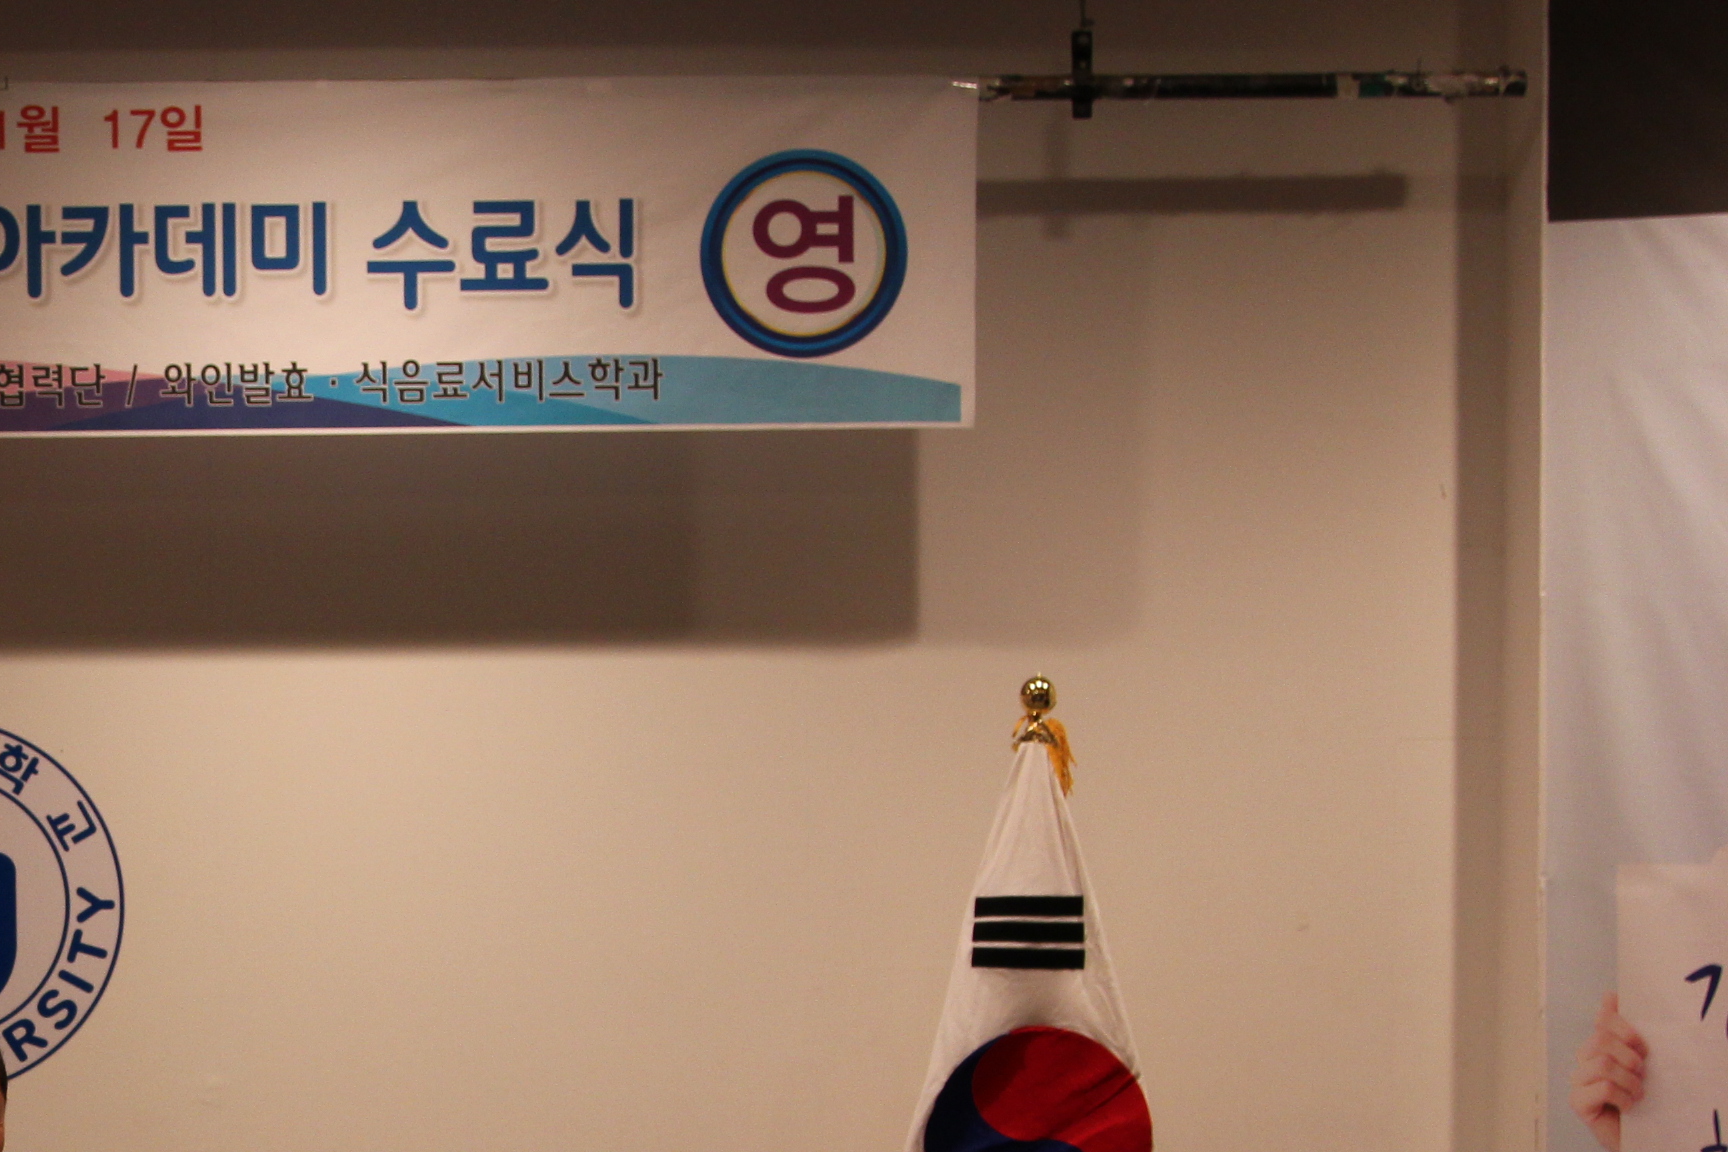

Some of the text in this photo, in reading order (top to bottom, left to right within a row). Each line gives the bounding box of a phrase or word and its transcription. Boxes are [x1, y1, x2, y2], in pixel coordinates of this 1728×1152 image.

[103, 104, 203, 152] 17일
[366, 198, 636, 310] 수료식
[752, 195, 855, 314] 영
[160, 362, 314, 406] 와인발효
[356, 357, 663, 403] 식음료서비스학과
